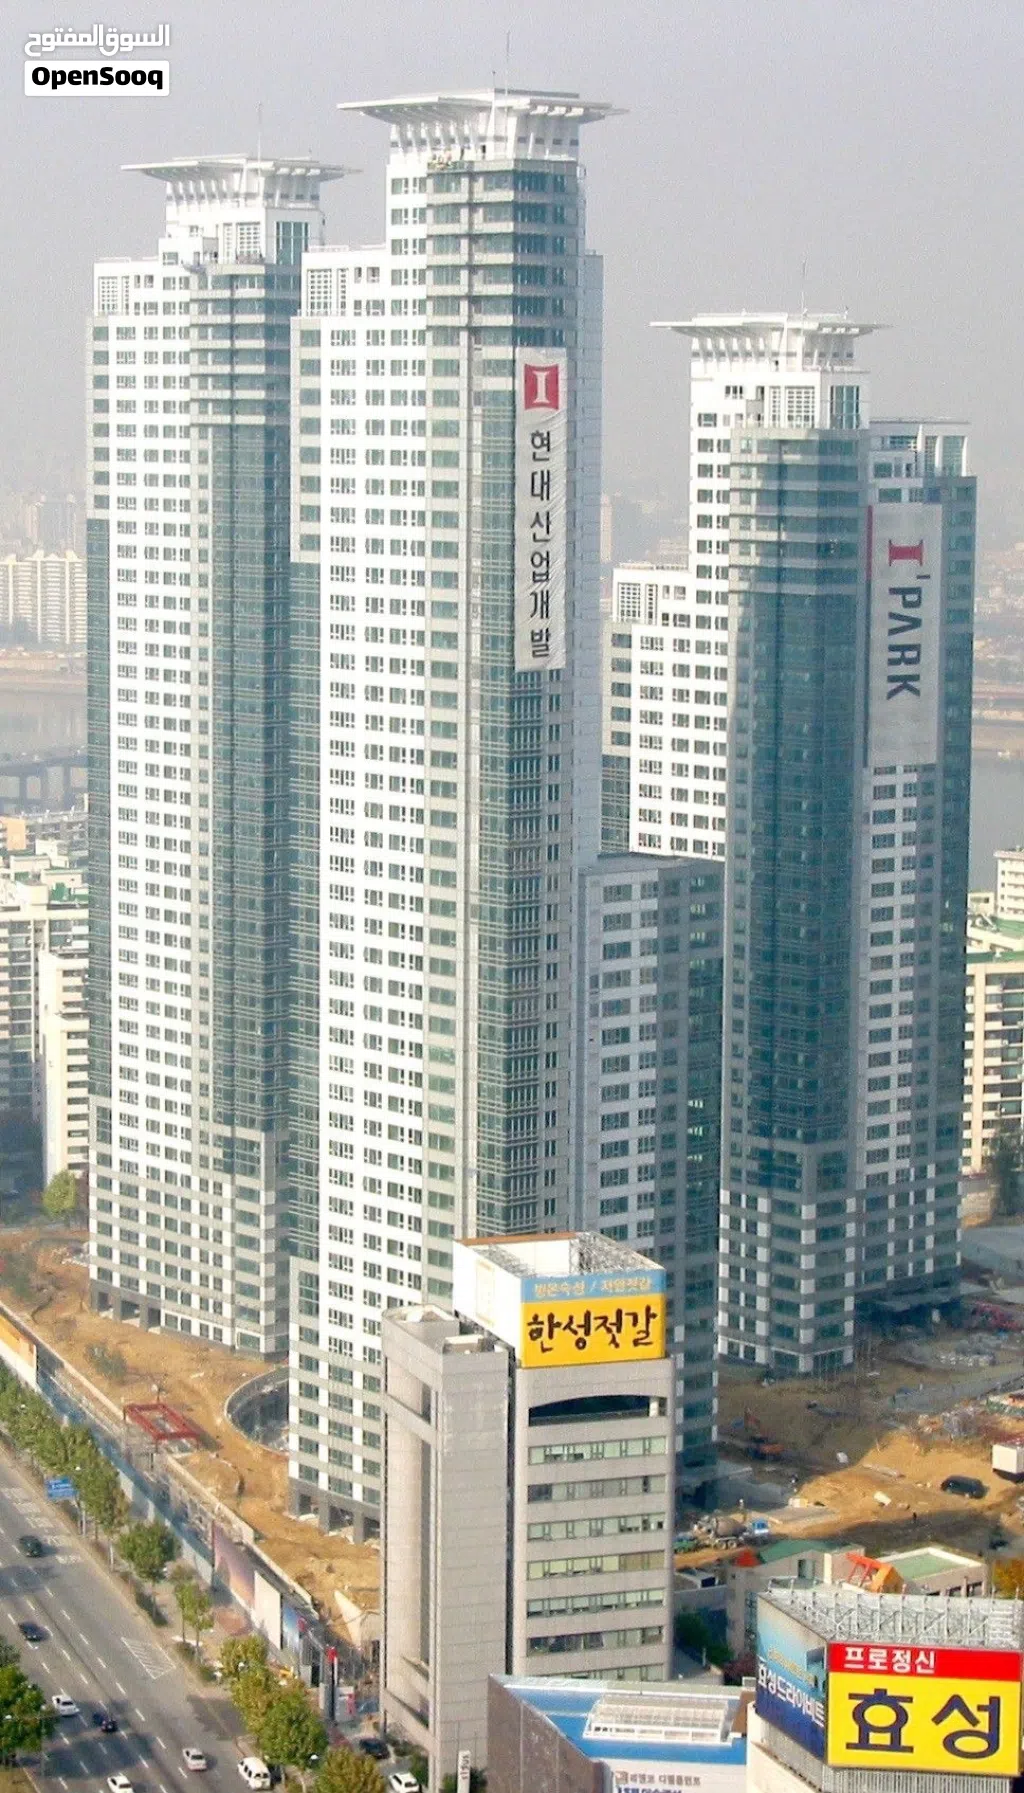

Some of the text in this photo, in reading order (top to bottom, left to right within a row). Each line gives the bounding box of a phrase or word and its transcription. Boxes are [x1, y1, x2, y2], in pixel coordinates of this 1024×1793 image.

[530, 430, 551, 658] 현대산업개발
[527, 1304, 658, 1353] 한성젓갈
[844, 1646, 936, 1675] 프로정신
[845, 1688, 1001, 1760] 효성
